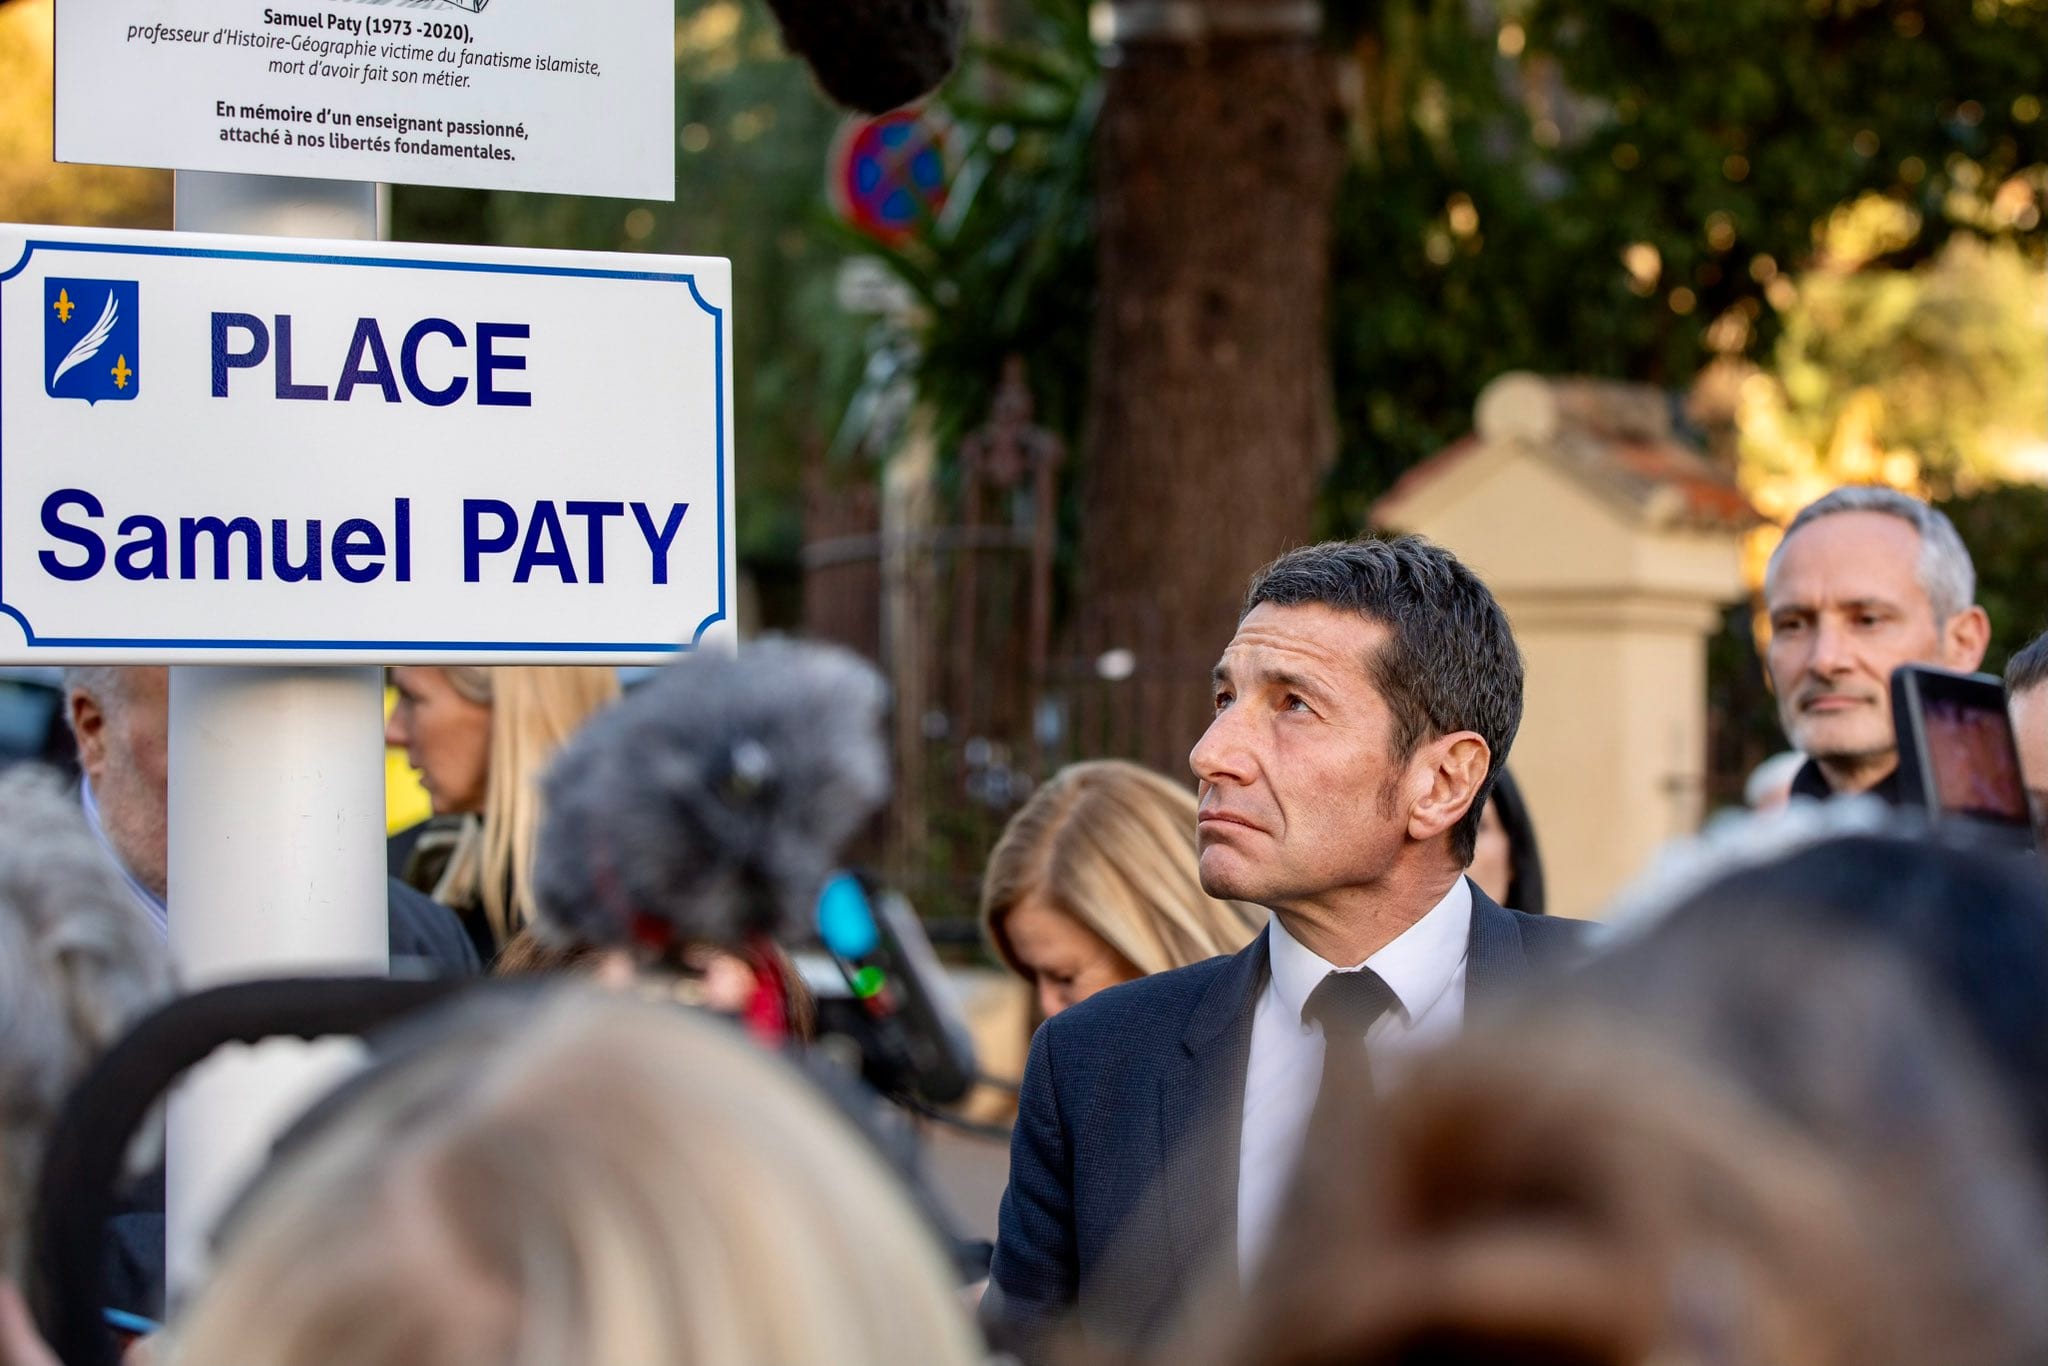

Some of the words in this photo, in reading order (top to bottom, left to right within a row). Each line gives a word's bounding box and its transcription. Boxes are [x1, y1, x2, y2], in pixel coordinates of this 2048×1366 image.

[263, 8, 324, 29] Samuel
[327, 13, 362, 37] Paty
[365, 15, 412, 37] (1973
[127, 22, 210, 45] professeur
[380, 42, 434, 63] victime
[437, 46, 456, 64] du
[457, 47, 532, 70] fanatisme
[535, 54, 601, 78] islamiste,
[268, 60, 305, 76] mort
[308, 59, 361, 80] d'avoir
[360, 63, 389, 85] fait
[391, 69, 418, 84] son
[421, 69, 471, 88] métier.
[216, 100, 236, 118] En
[239, 103, 313, 124] mémoire
[316, 107, 352, 127] d'un
[355, 112, 444, 135] enseignant
[446, 119, 529, 141] passionné,
[219, 126, 281, 146] attaché
[283, 129, 293, 146] à
[296, 133, 326, 149] nos
[328, 131, 391, 153] libertés
[393, 136, 516, 162] fondamentales.
[212, 312, 531, 406] PLACE
[39, 489, 410, 583] Samuel
[463, 499, 689, 584] PATY
